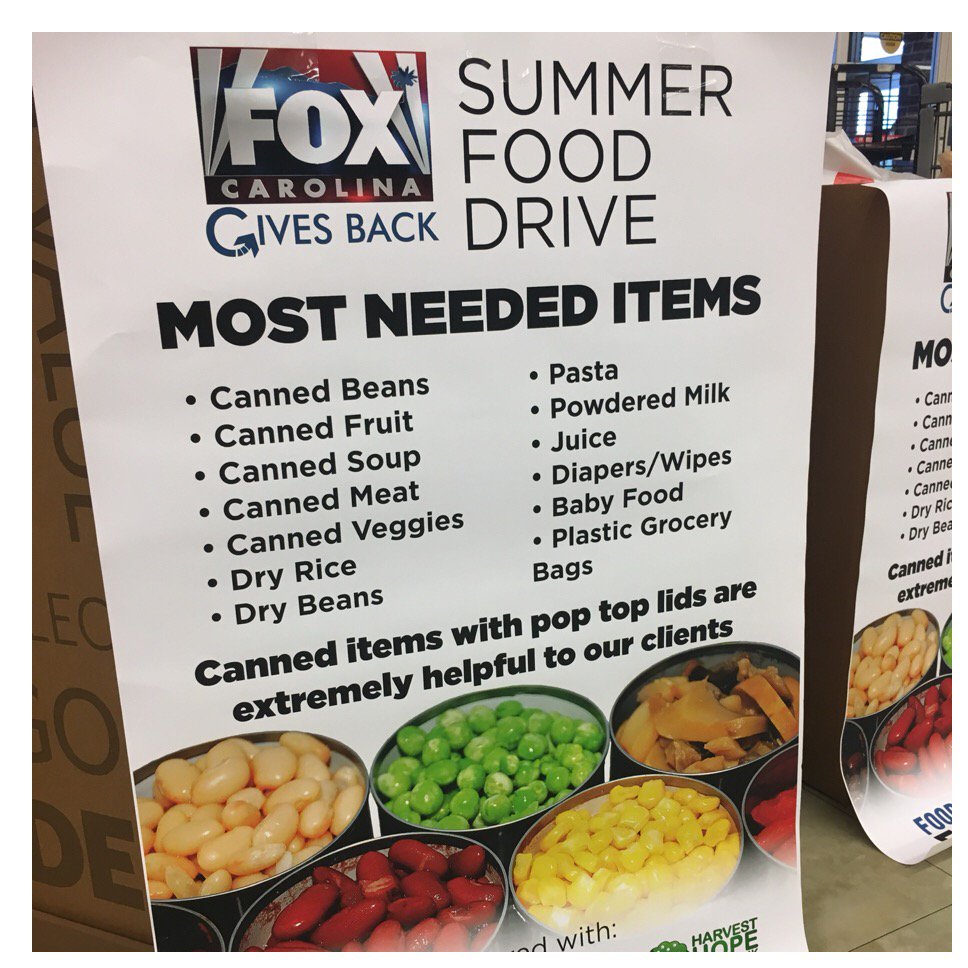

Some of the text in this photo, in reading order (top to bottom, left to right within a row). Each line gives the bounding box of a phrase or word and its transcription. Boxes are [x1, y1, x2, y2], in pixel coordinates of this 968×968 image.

[459, 58, 732, 116] SUMMER
[224, 88, 410, 165] FOX
[463, 129, 651, 183] FOOD
[221, 177, 422, 198] CAROLINA
[206, 207, 439, 257] GIVES BACK
[466, 195, 656, 250] DRIVE
[157, 275, 761, 349] MOST NEEDED ITEMS
[550, 361, 617, 384] Pasta
[211, 378, 429, 410] Canned Beans
[551, 382, 730, 418] Powdered Milk
[215, 410, 413, 447] Canned Fruit
[551, 428, 616, 452] Juice
[219, 450, 420, 484] Canned Soup
[553, 450, 731, 484] Diapers/Wipes
[224, 481, 419, 520] Canned Meat
[553, 482, 683, 516] Baby Food
[228, 512, 463, 555] Canned Veggies
[553, 511, 732, 548] Plastic Grocery
[231, 558, 356, 590] Dry Rice
[534, 560, 592, 582] Bags
[235, 589, 383, 624] Dry Beans
[195, 581, 757, 686] Canned items with pop top lids are
[233, 619, 733, 722] extremely helpful to our clients
[557, 922, 617, 951] with:
[692, 917, 758, 946] HARVEST
